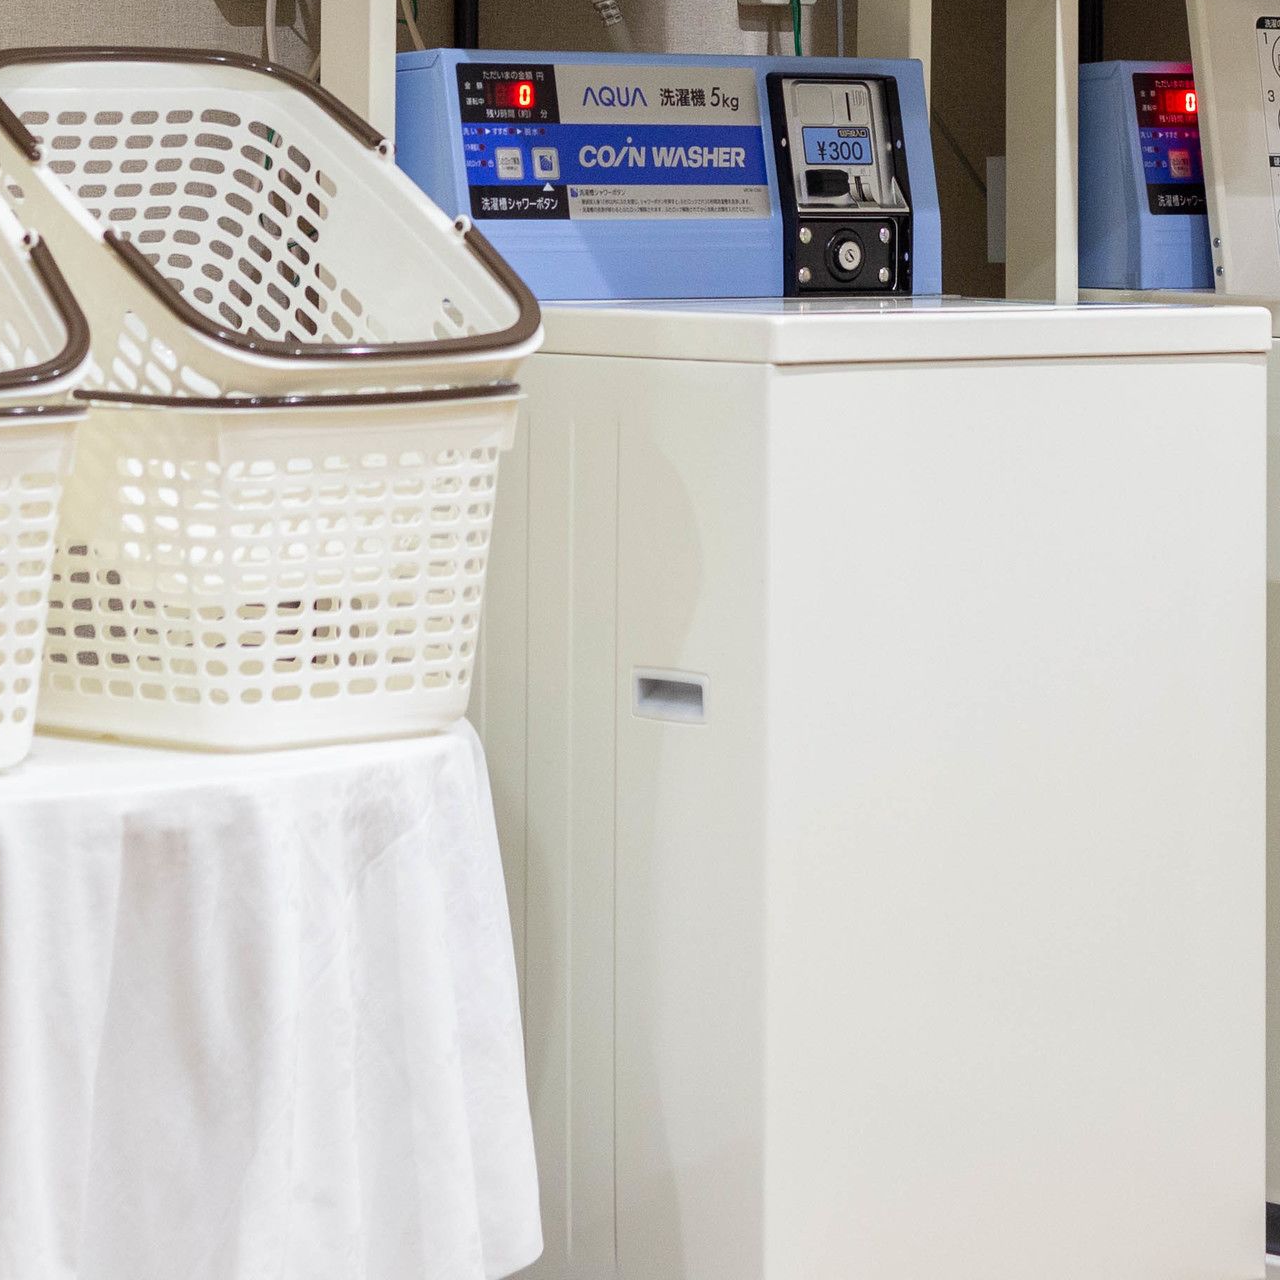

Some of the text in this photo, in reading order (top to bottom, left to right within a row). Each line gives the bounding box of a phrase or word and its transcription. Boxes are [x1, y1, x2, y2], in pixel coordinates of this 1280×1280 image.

[1263, 33, 1269, 44] 1
[483, 71, 533, 80] ただいまの金額
[519, 84, 531, 106] 0
[582, 86, 648, 108] AQUA
[659, 87, 706, 108] 洗濯機
[1185, 93, 1196, 112] 0
[1268, 90, 1275, 103] 3
[653, 147, 746, 168] WASHER
[817, 140, 863, 161] ¥300
[481, 196, 558, 211] 洗濯槽シャワーボタン
